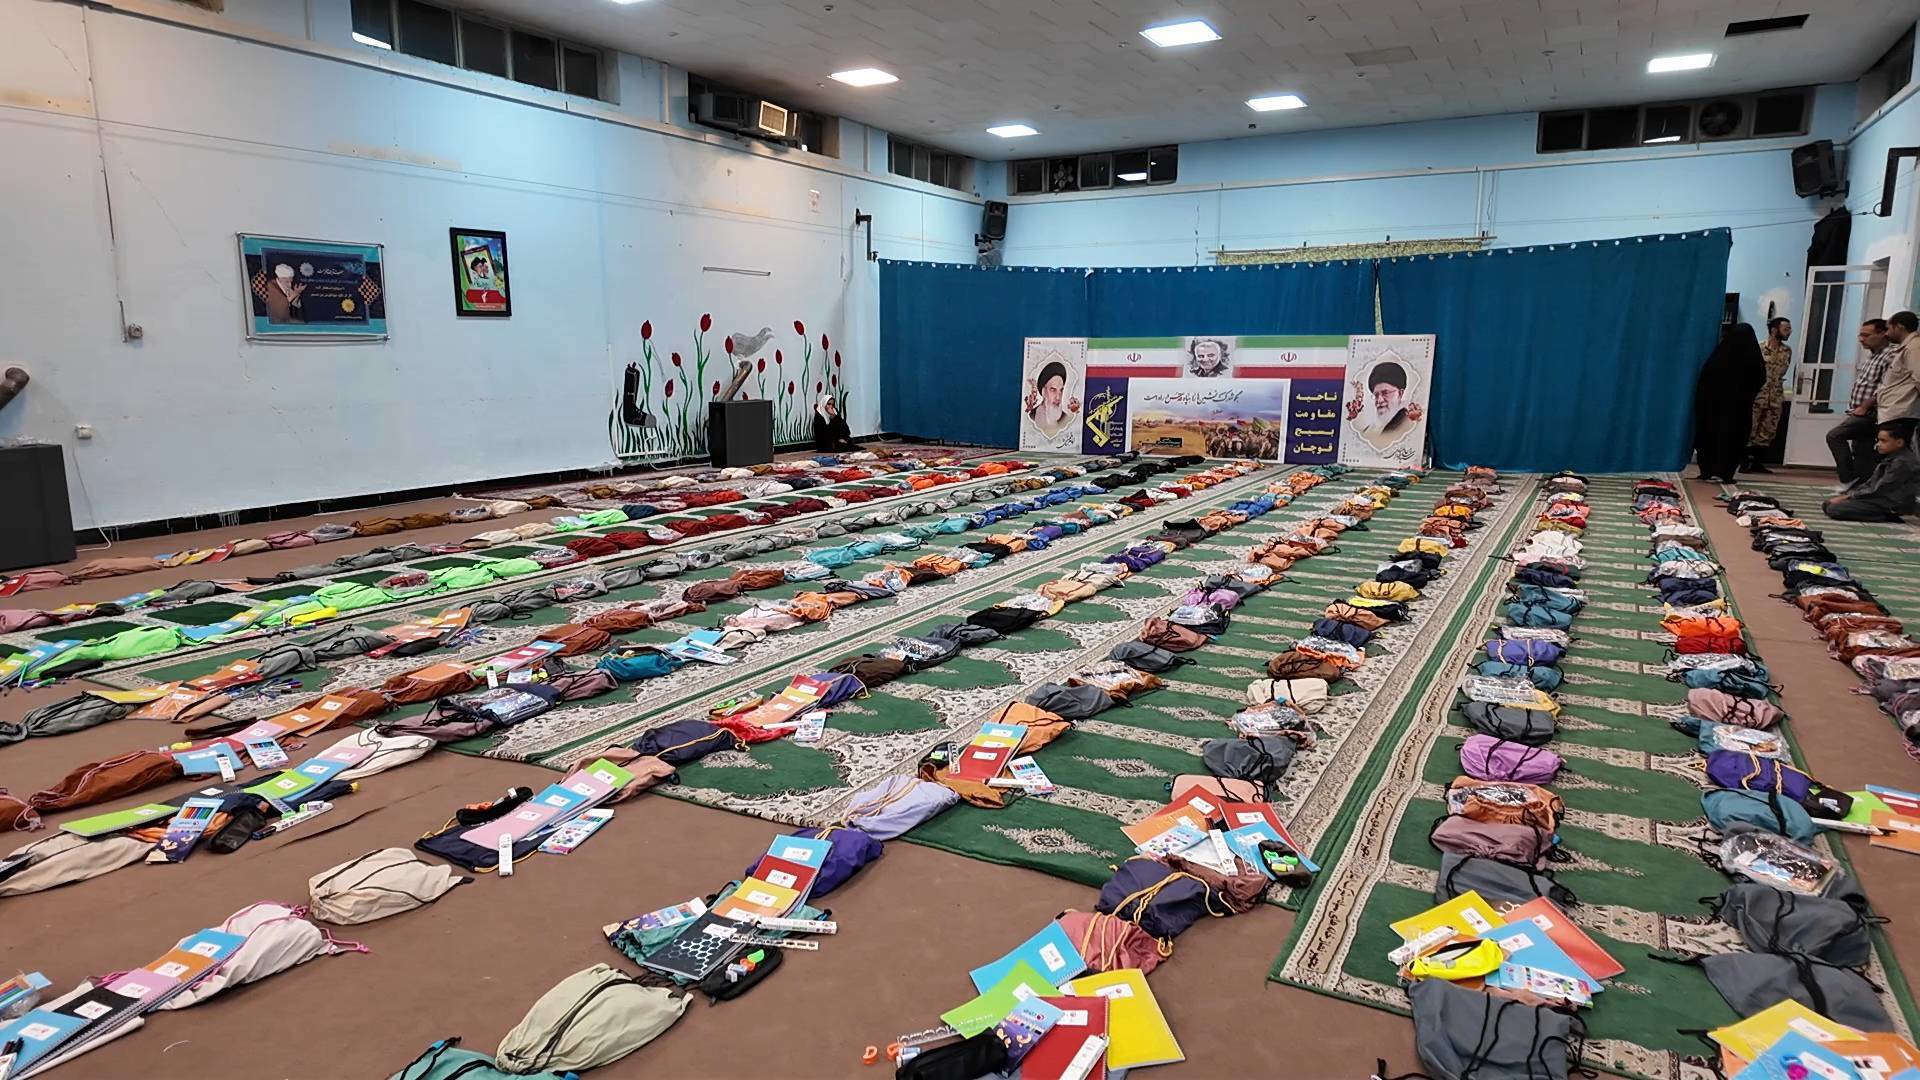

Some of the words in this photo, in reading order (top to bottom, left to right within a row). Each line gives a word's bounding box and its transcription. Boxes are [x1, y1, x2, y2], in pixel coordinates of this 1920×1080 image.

[1296, 391, 1337, 403] ناحیه
[1294, 427, 1335, 438] بسیج
[1293, 442, 1333, 455] قوچان
